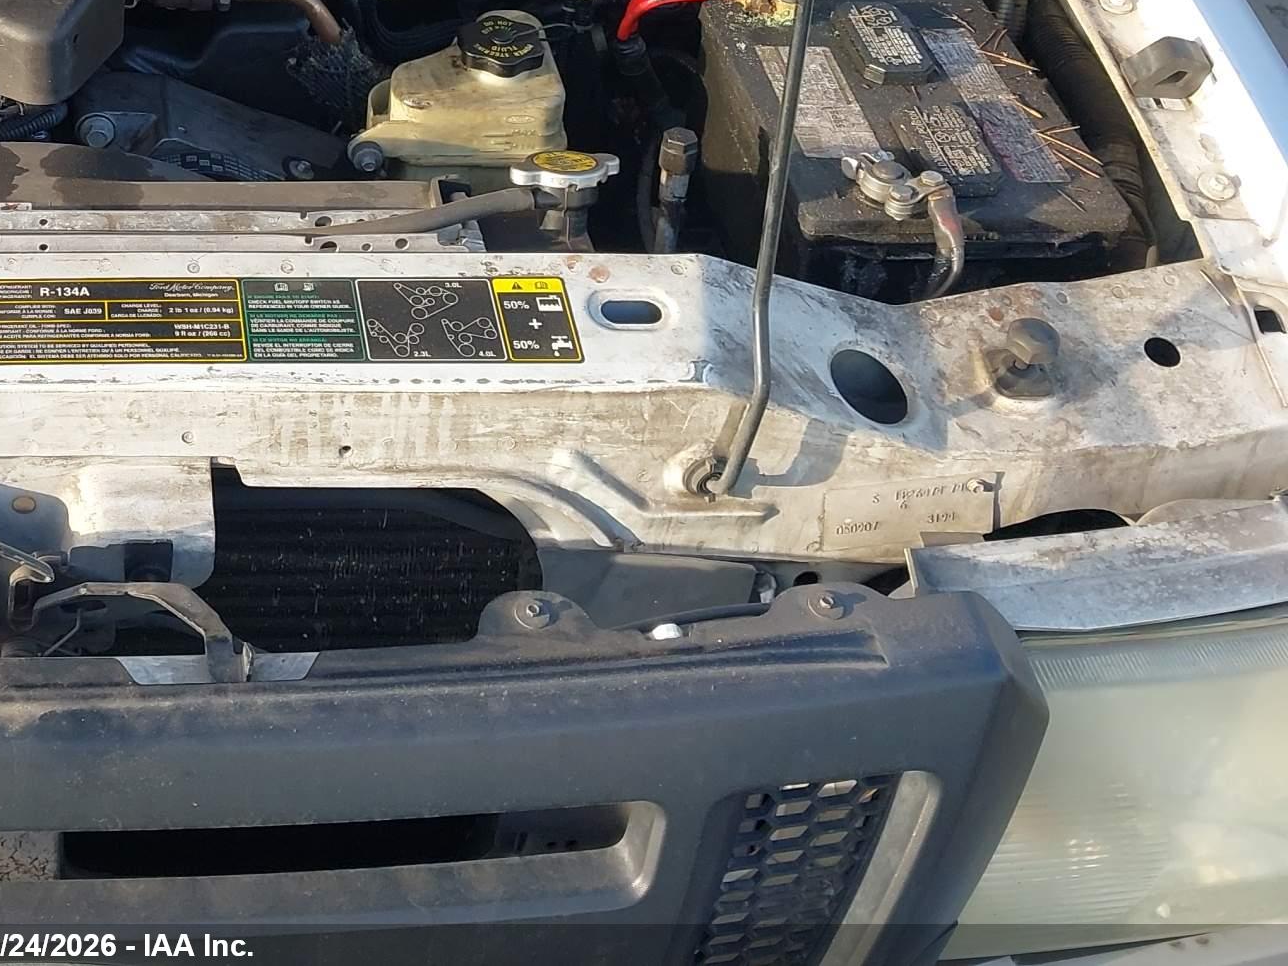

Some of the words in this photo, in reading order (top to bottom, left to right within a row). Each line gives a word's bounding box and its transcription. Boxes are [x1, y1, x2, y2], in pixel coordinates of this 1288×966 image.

[40, 287, 90, 297] R-134A
[148, 283, 170, 291] Ford
[170, 283, 192, 291] Motor
[503, 300, 530, 310] 50%
[513, 340, 540, 350] 50%
